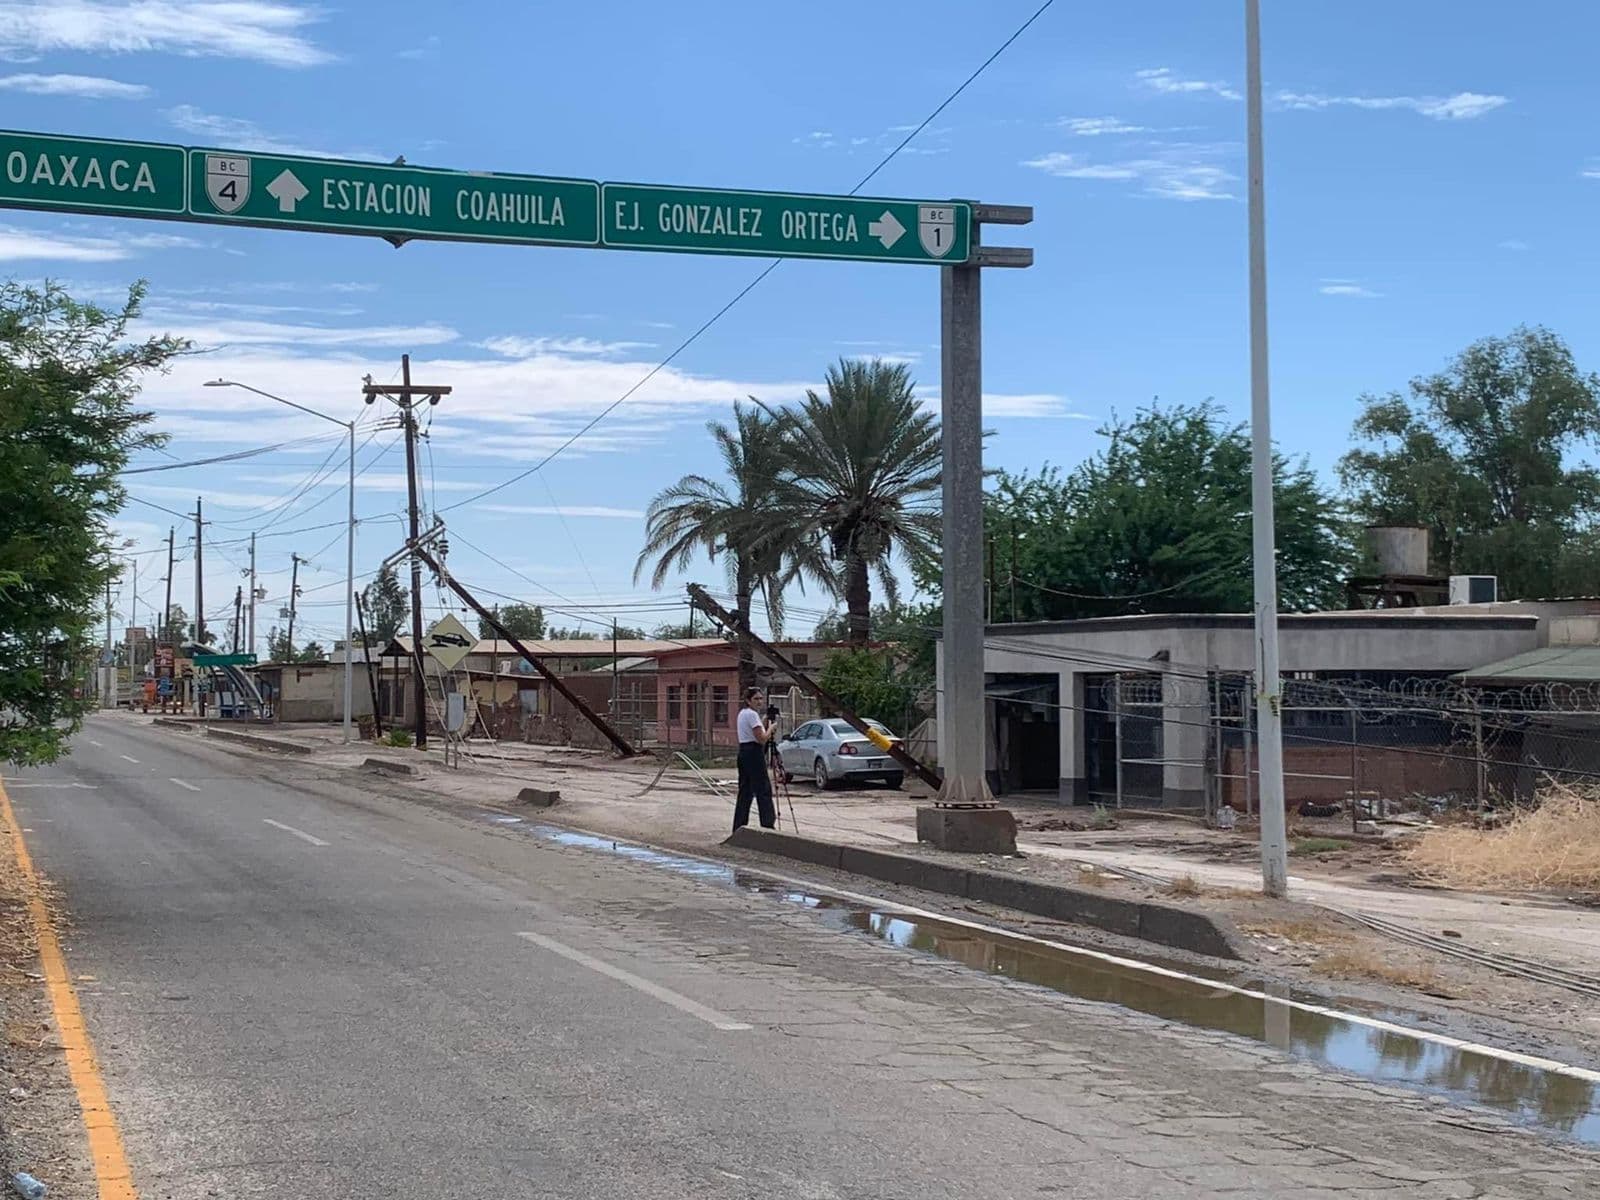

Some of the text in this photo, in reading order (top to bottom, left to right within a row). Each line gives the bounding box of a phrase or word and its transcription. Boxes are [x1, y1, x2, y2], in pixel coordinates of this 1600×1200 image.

[7, 151, 156, 193] OAXACA
[219, 180, 238, 202] 4
[322, 159, 565, 226] ESTACION COAHUILA
[658, 203, 762, 237] GONZALEZ
[781, 208, 859, 242] ORTEGA
[933, 227, 941, 247] 1
